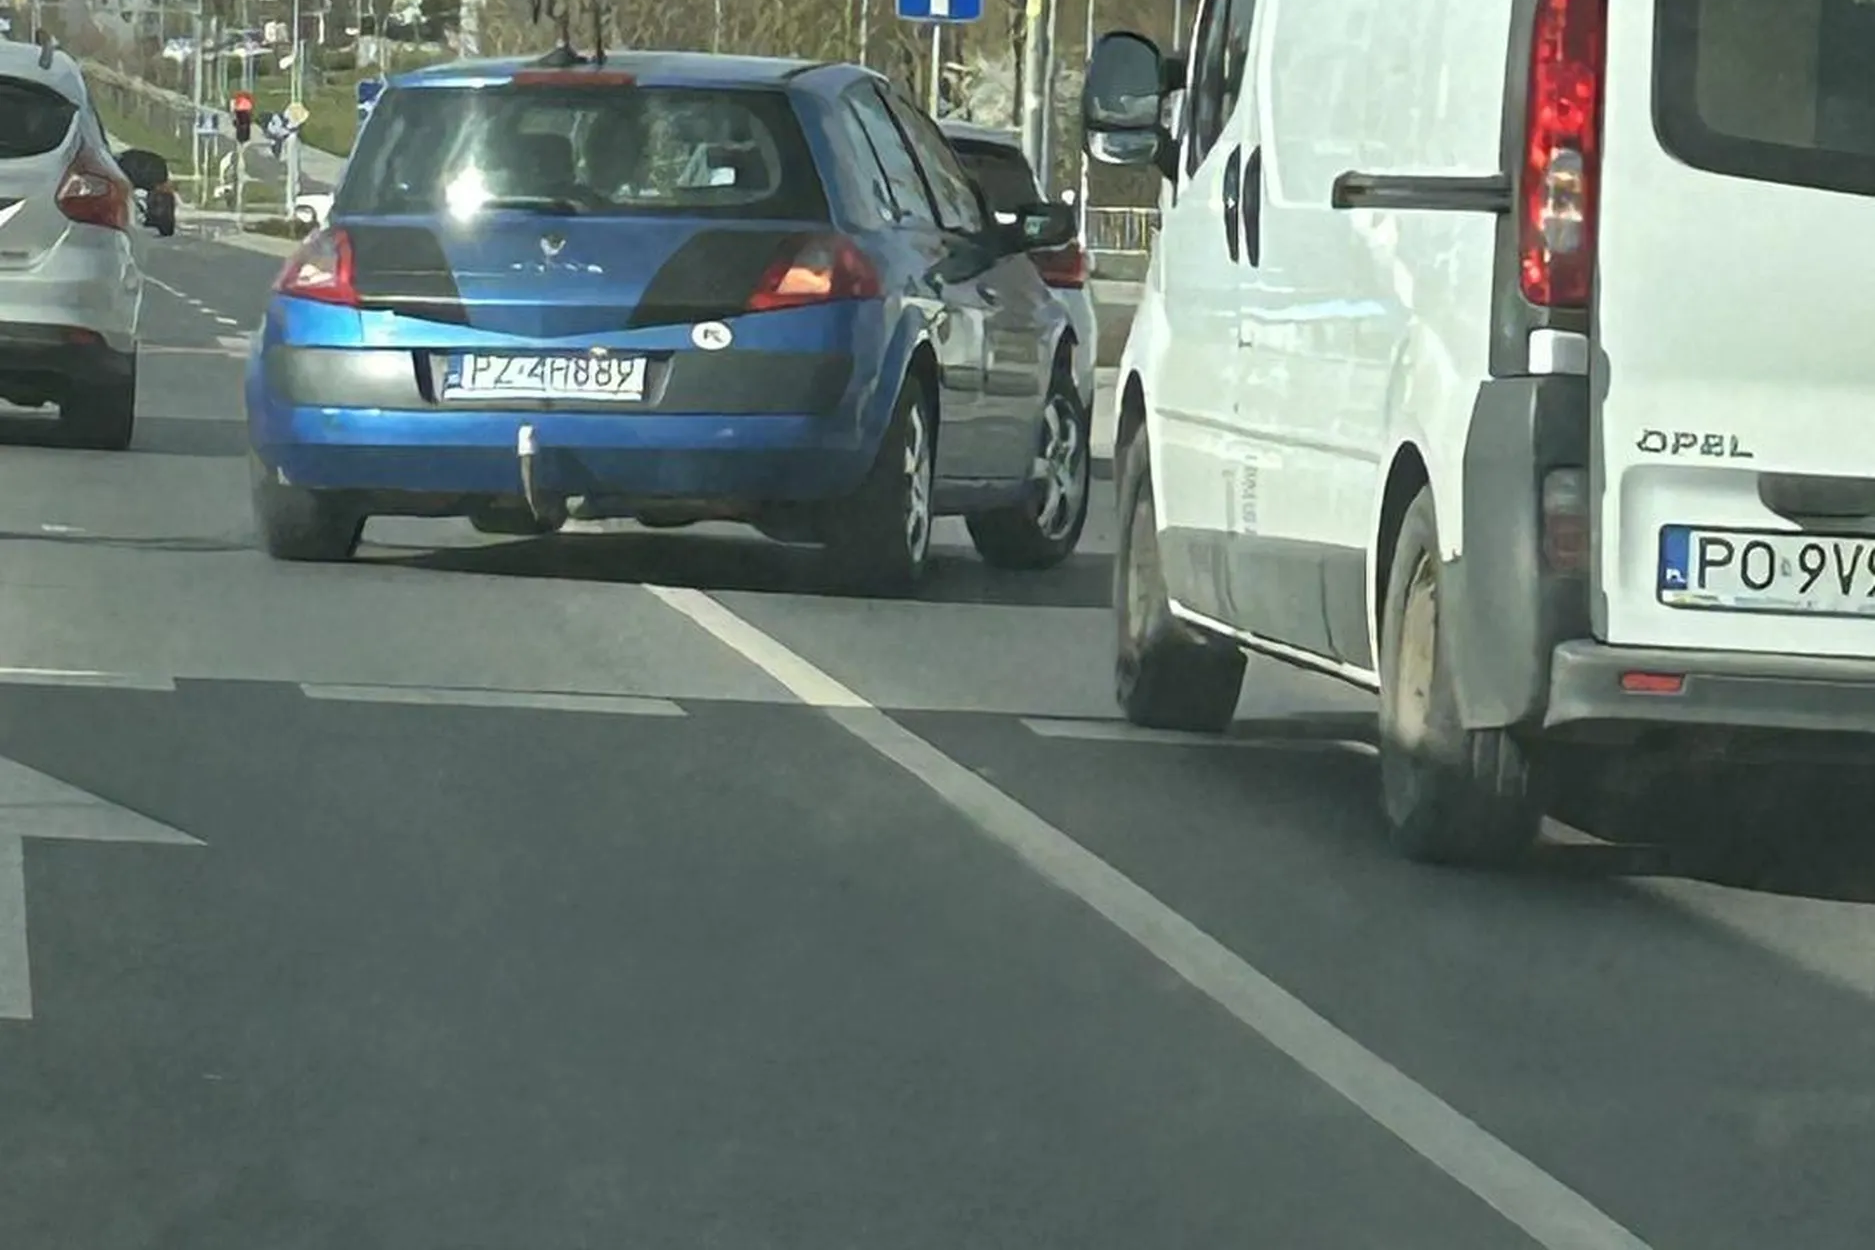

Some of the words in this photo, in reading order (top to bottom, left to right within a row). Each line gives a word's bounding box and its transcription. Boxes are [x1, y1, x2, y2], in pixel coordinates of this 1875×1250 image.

[472, 355, 514, 388] PZ
[1637, 429, 1754, 458] OPEL
[1698, 536, 1775, 590] PO
[1799, 542, 1875, 597] 9V
